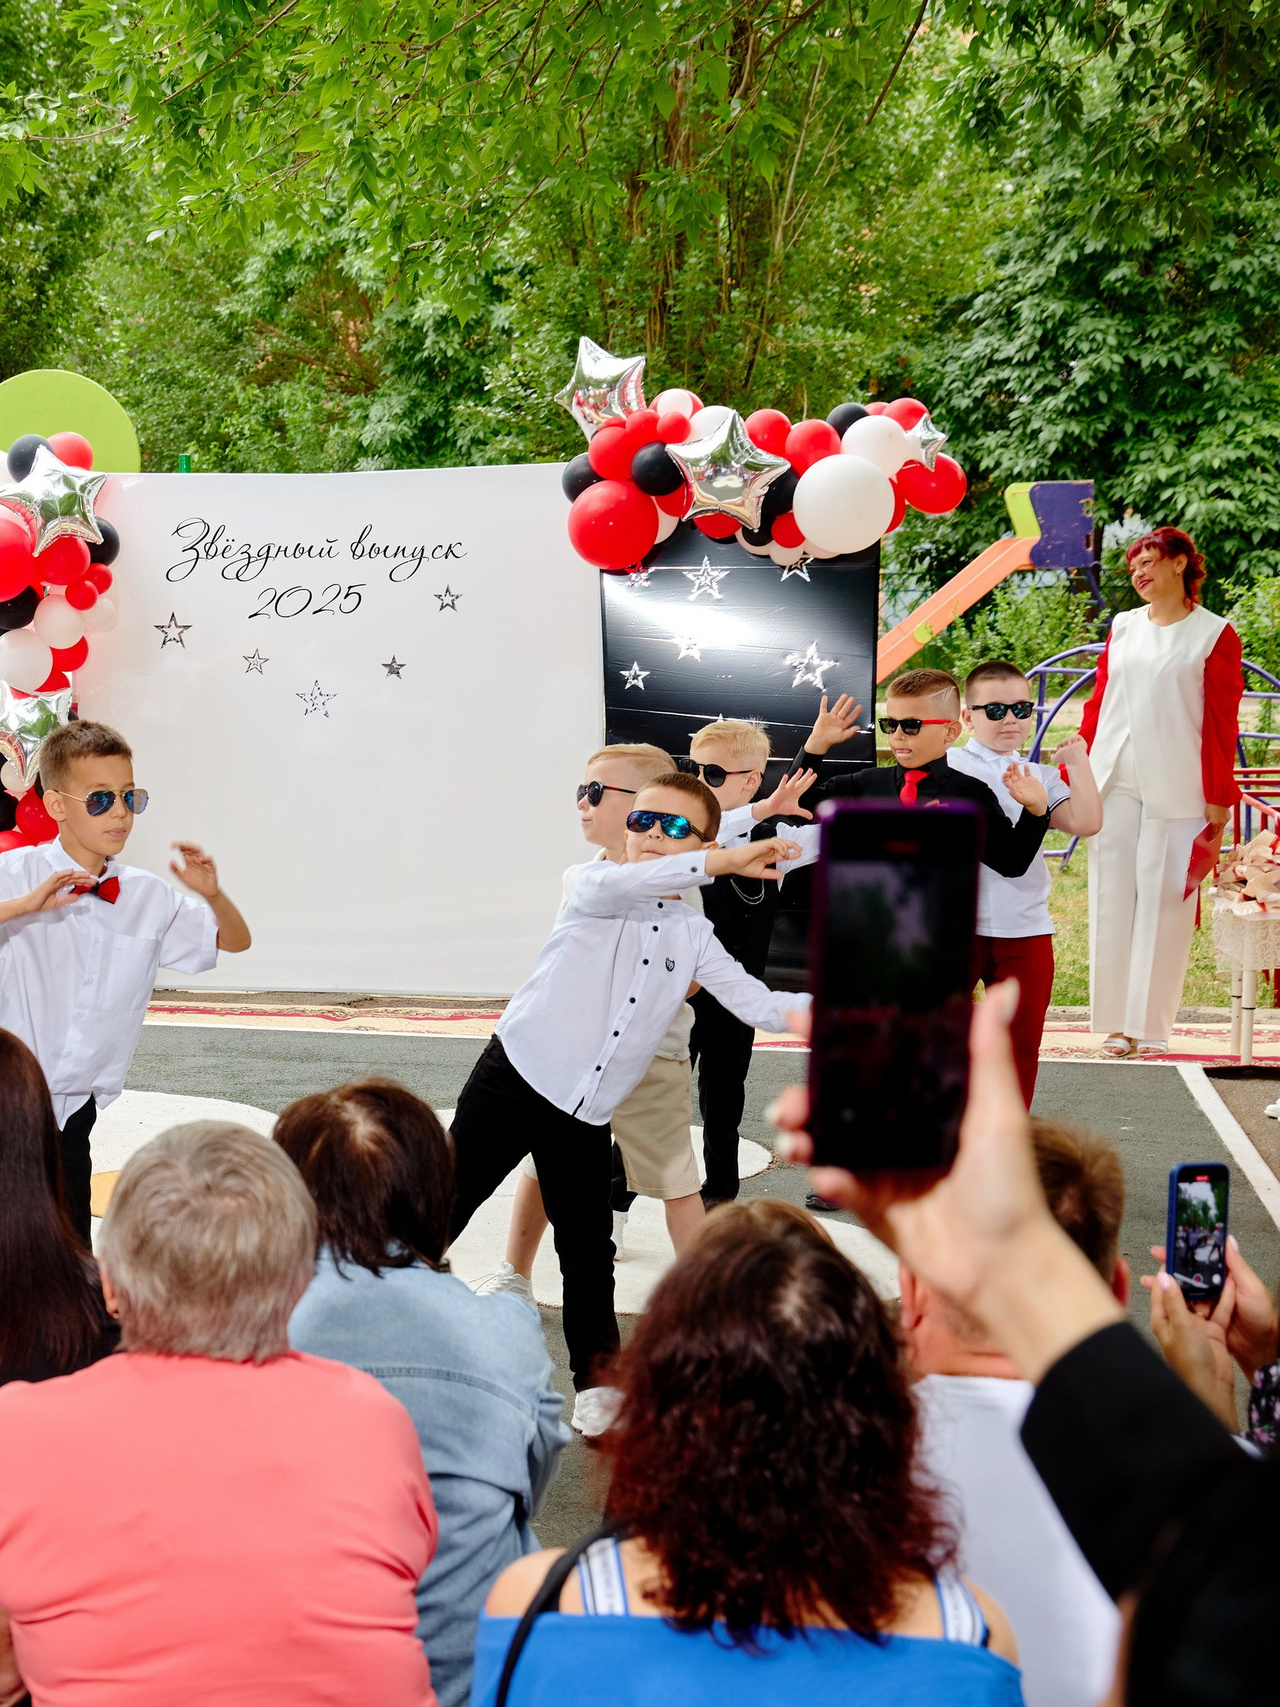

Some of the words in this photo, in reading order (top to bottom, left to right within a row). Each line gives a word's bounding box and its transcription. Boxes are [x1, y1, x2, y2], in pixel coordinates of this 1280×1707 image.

[166, 517, 340, 582] Звёздный
[350, 523, 467, 582] выпуск
[248, 584, 366, 619] 2025
